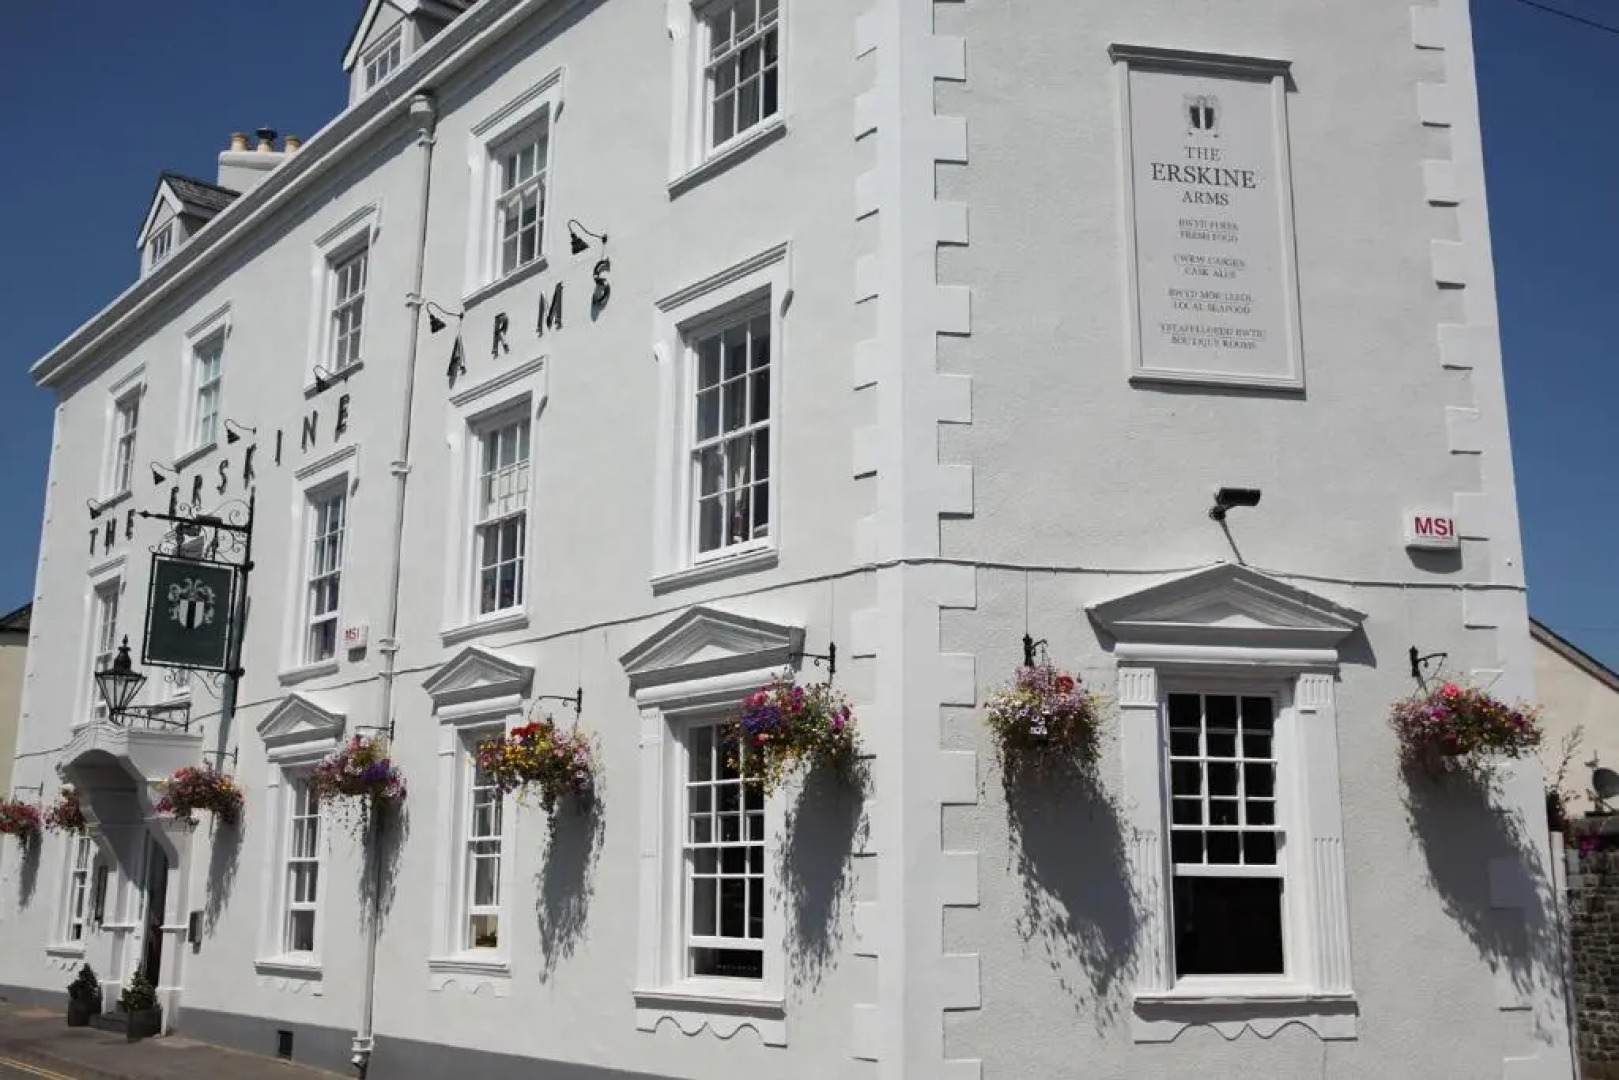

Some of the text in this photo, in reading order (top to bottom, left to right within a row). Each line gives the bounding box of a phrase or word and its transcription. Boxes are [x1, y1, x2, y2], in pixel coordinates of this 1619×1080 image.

[1183, 145, 1221, 161] THE
[1150, 162, 1256, 189] ERSKINE
[1182, 190, 1230, 206] ARMS
[1184, 267, 1209, 276] CASK
[89, 257, 611, 557] THE ERSKINE ARMS
[1415, 517, 1454, 537] MSI
[345, 627, 360, 640] MSI
